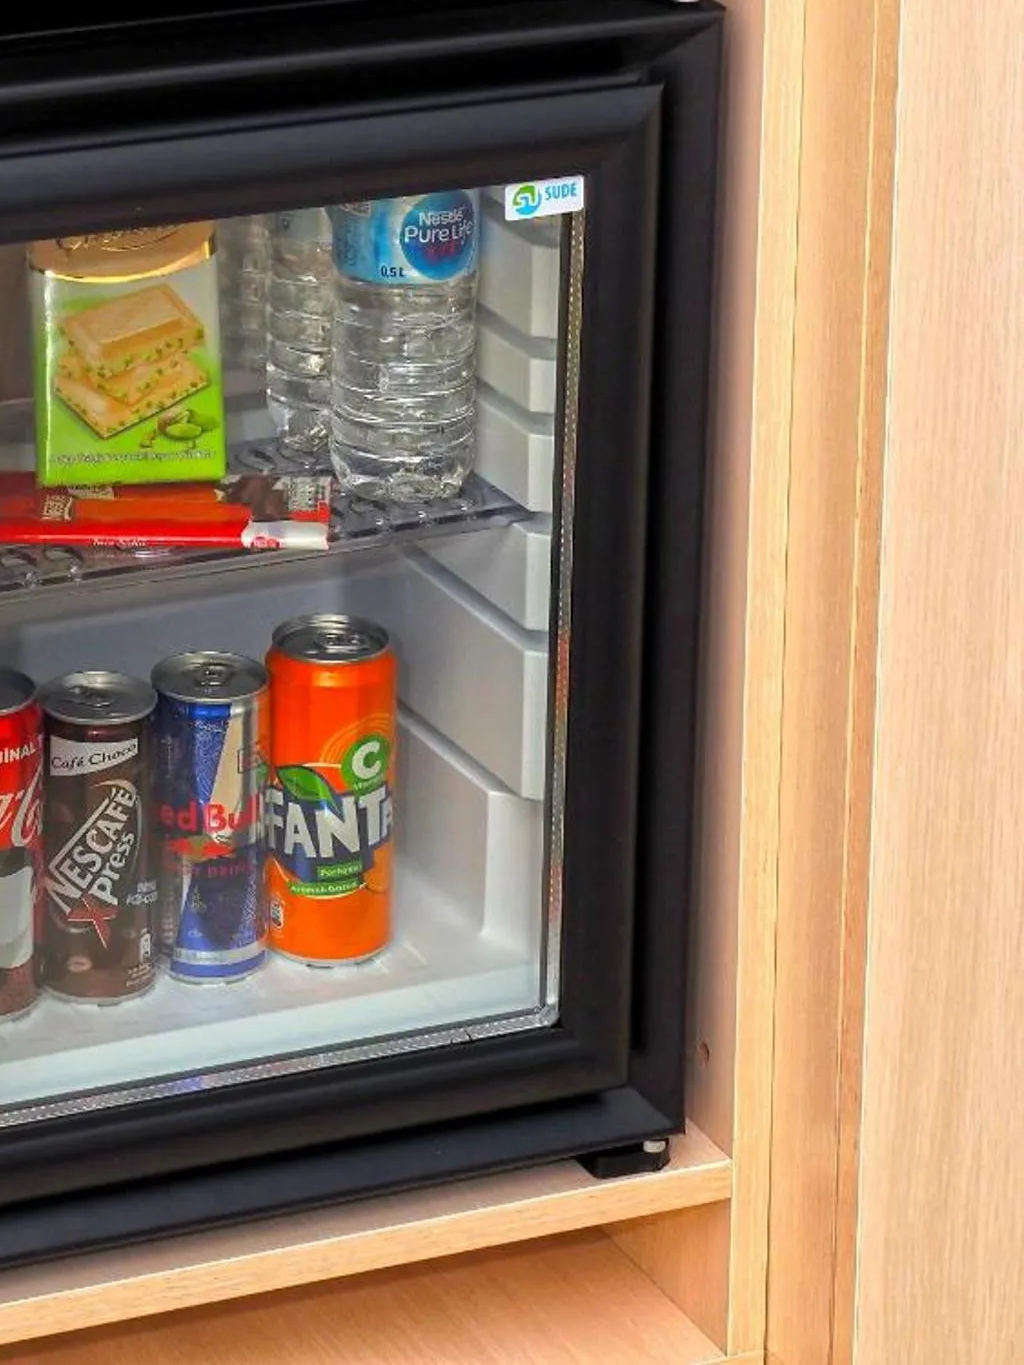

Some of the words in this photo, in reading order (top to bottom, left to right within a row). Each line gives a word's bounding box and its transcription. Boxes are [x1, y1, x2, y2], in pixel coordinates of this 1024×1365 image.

[544, 182, 578, 201] SUDE
[404, 225, 450, 244] Pure
[452, 219, 475, 245] Life
[51, 755, 86, 770] Café
[88, 741, 137, 766] Choco
[159, 798, 198, 833] ed
